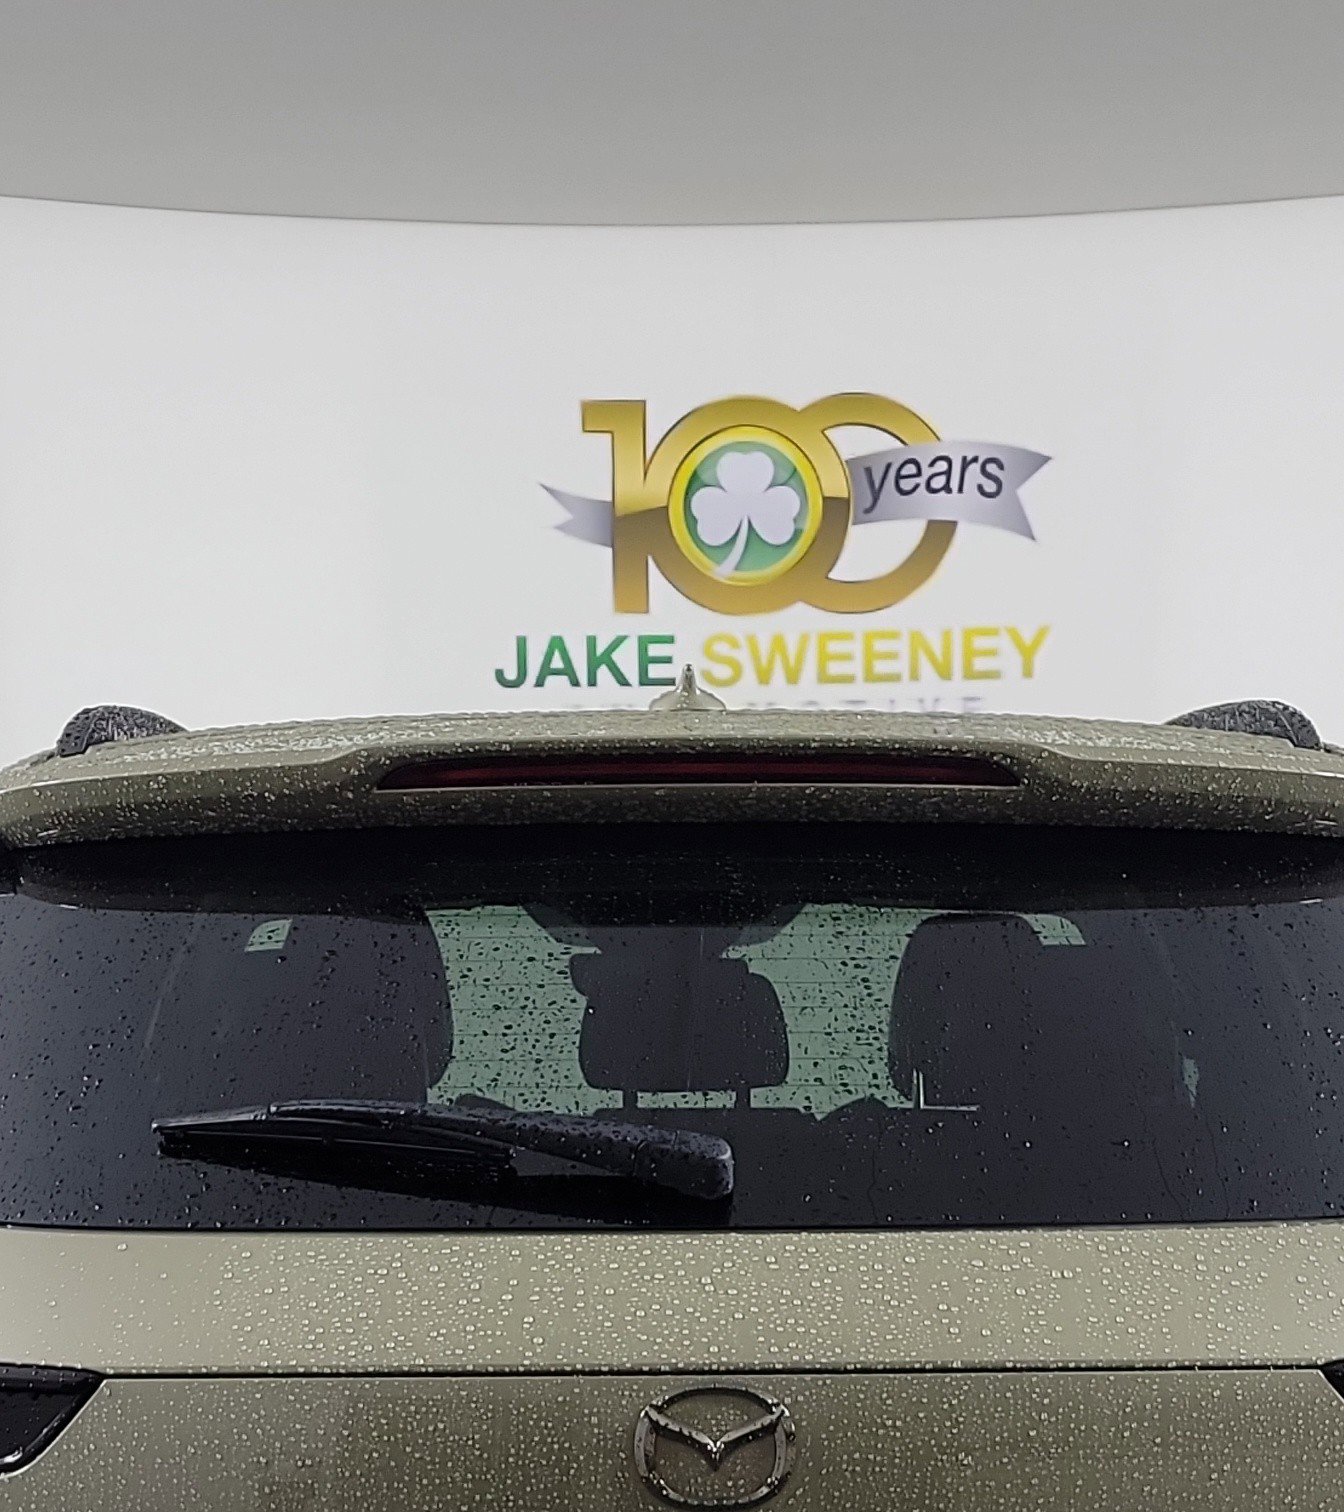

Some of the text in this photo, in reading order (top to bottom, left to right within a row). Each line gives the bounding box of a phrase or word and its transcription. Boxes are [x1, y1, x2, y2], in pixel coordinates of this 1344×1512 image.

[580, 391, 958, 614] 100
[861, 452, 1006, 515] years
[494, 624, 1051, 688] JAKE SWEENEY
